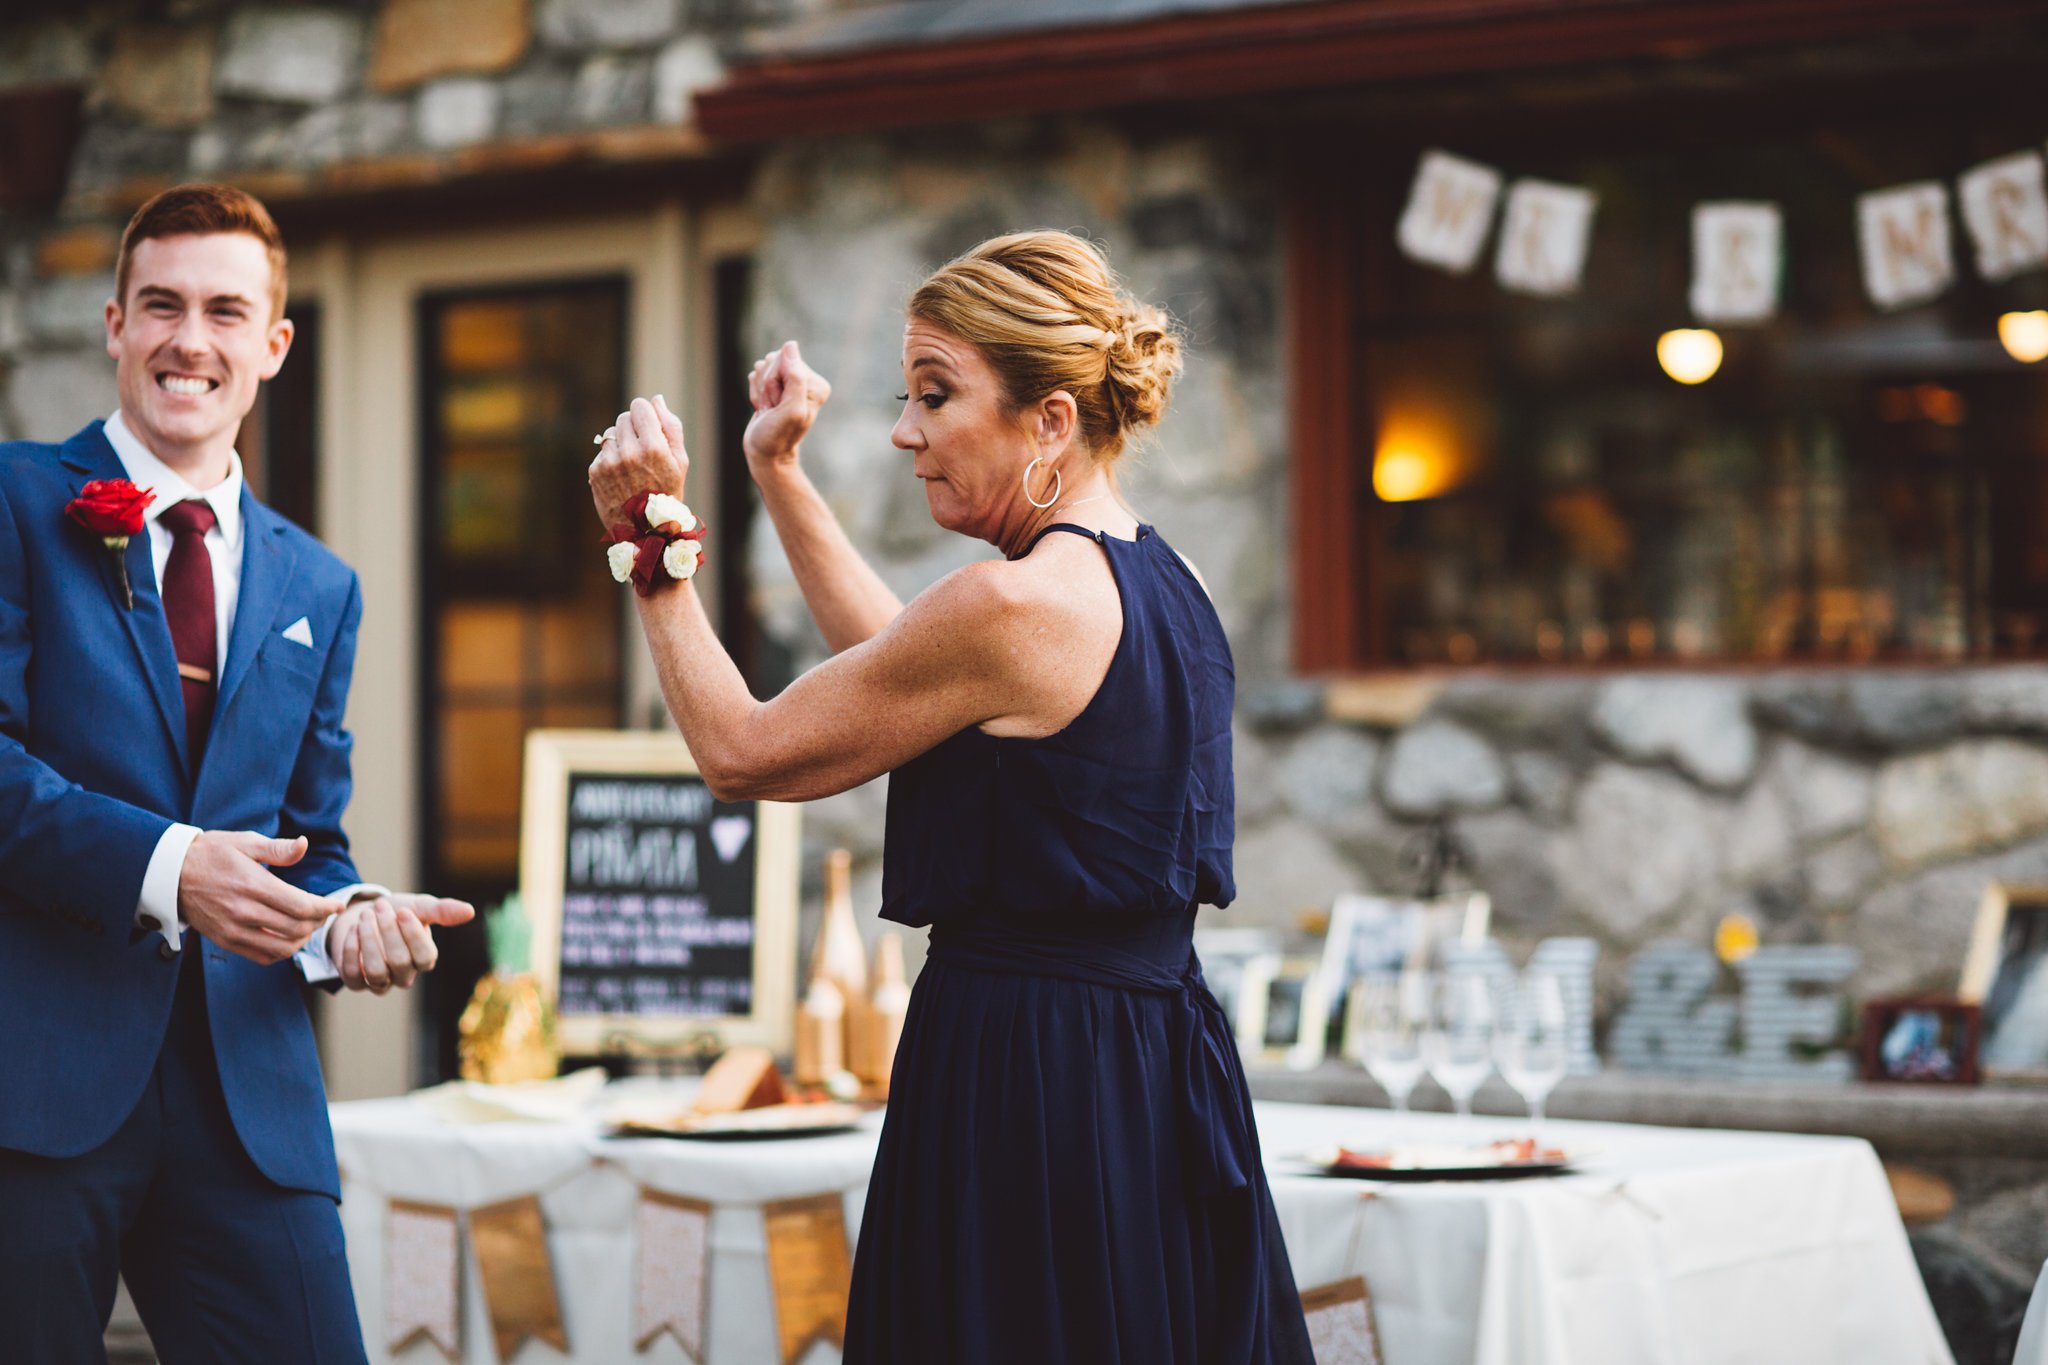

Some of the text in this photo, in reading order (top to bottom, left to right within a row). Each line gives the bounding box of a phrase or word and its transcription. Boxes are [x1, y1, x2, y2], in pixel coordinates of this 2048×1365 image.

[1438, 936, 1862, 1084] M & E
